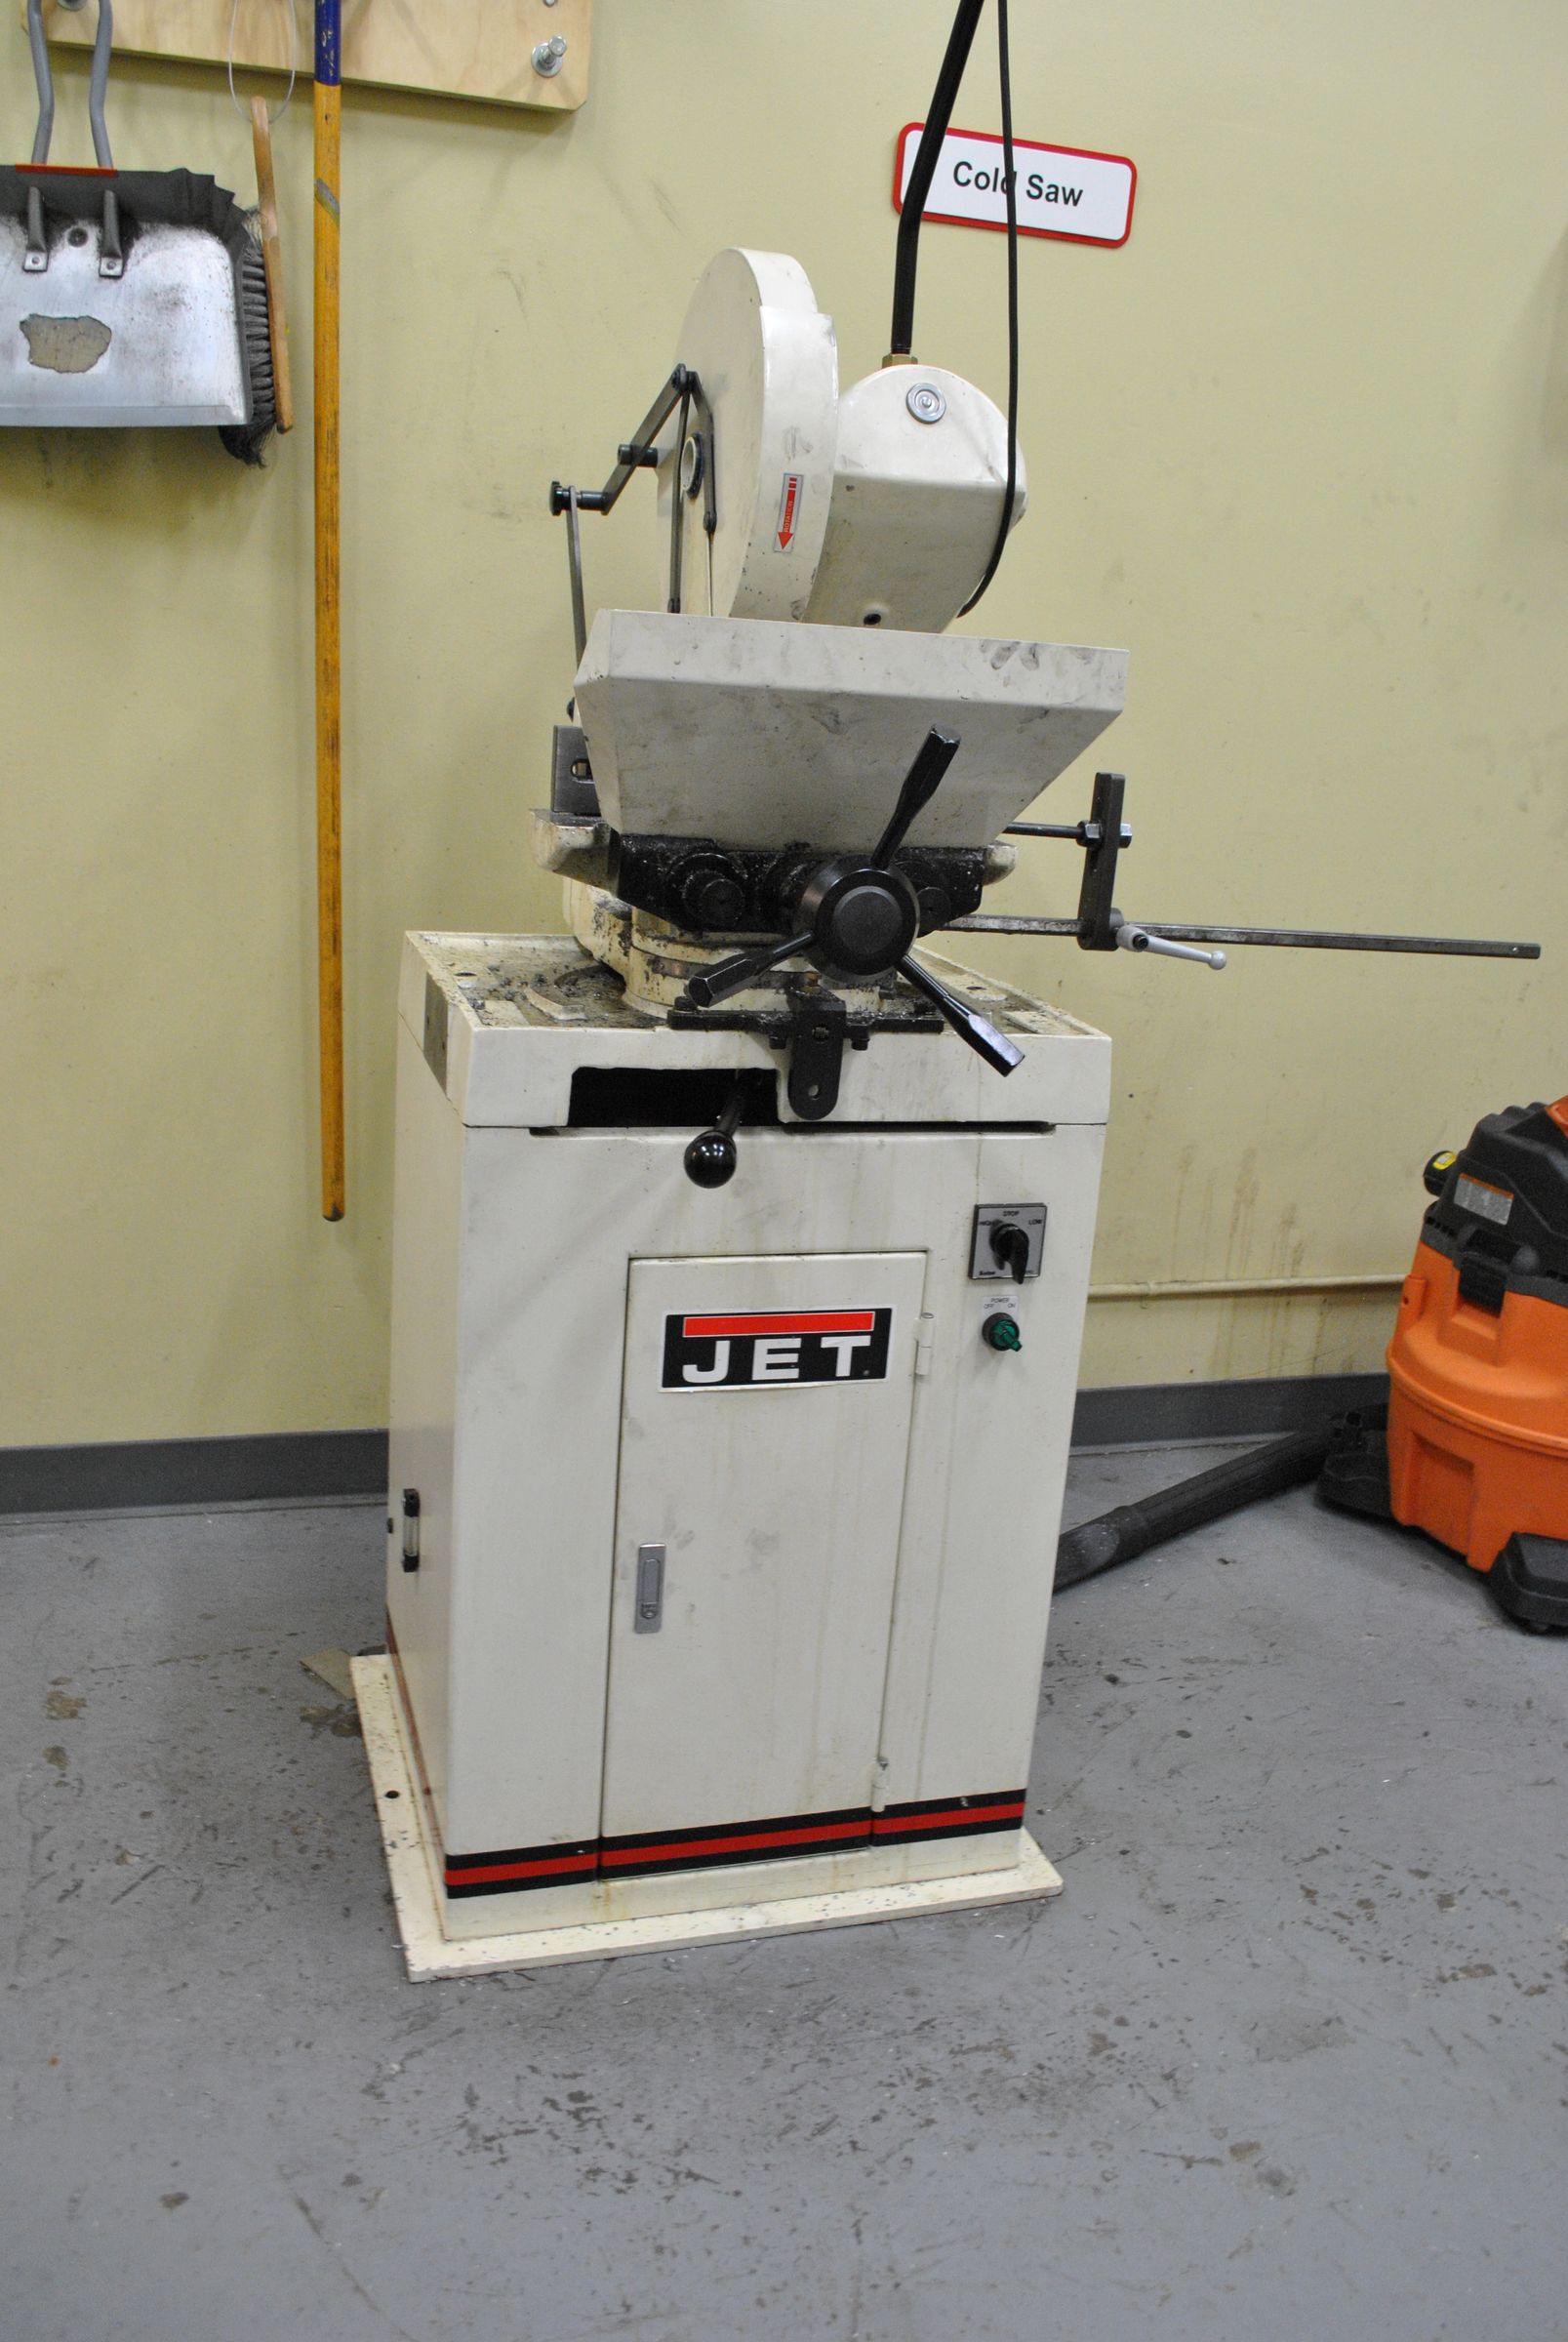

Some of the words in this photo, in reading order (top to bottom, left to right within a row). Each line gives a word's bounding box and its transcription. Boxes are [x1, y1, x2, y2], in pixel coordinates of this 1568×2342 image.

[1025, 174, 1083, 207] Saw
[784, 500, 795, 534] ROTATION
[683, 1335, 871, 1384] JET
